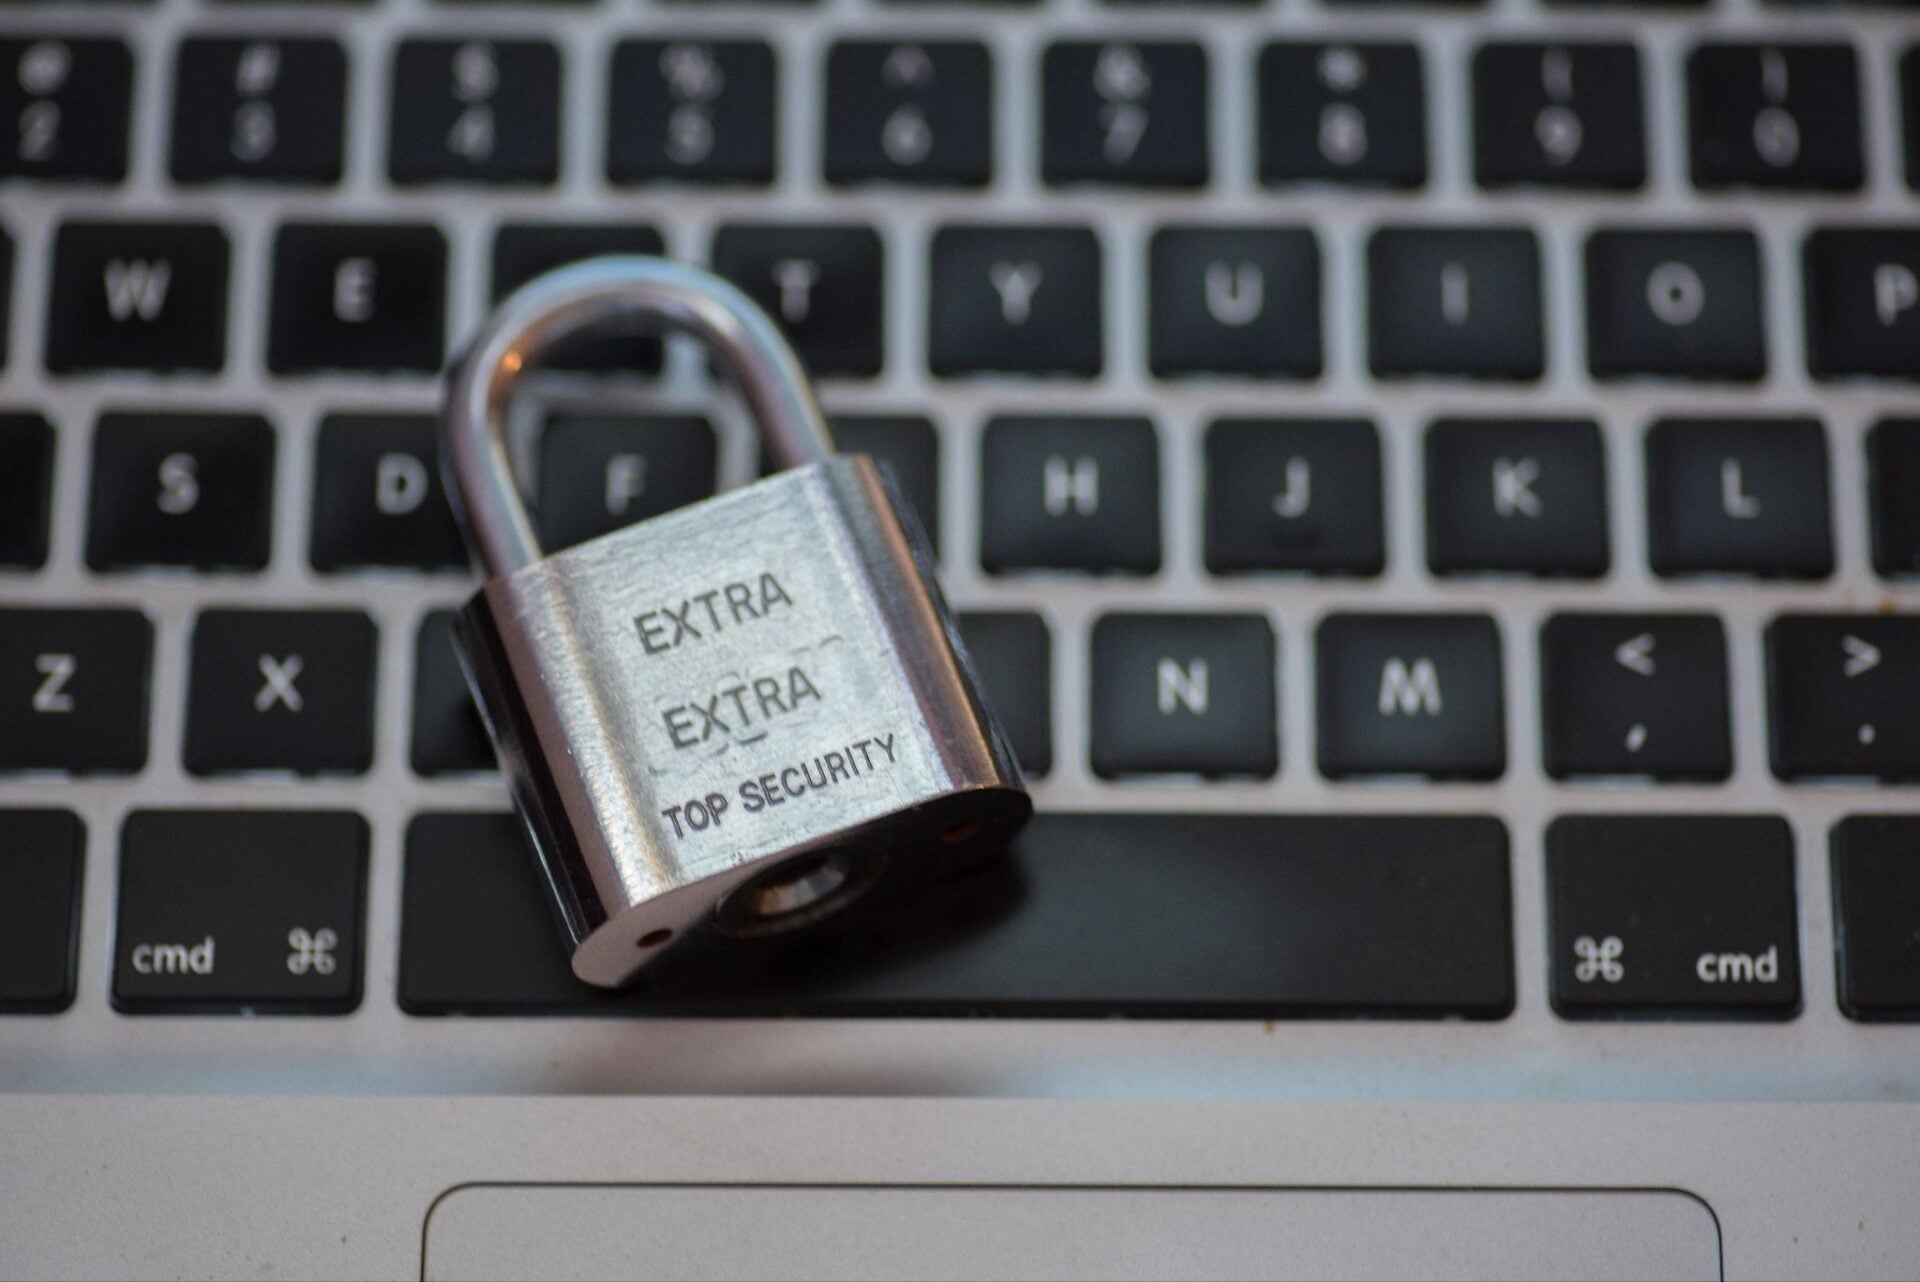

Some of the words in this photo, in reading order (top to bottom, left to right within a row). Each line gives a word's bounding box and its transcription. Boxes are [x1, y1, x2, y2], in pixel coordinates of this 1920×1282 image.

[105, 260, 170, 320] W
[335, 259, 377, 320] E
[773, 260, 818, 321] T
[991, 262, 1041, 323] Y
[1205, 264, 1263, 324] U
[1648, 263, 1704, 324] O
[1875, 266, 1917, 321] P
[158, 452, 199, 515] S
[377, 454, 427, 513] D
[607, 455, 645, 513] F
[1042, 457, 1100, 514] H
[1274, 457, 1311, 518] J
[1491, 459, 1540, 516] K
[1720, 459, 1759, 519] L
[633, 572, 793, 655] EXTRA
[32, 653, 76, 713] Z
[254, 654, 303, 712] X
[661, 666, 822, 749] EXTRA
[1156, 657, 1210, 715] N
[1377, 658, 1443, 716] M
[661, 793, 728, 839] TOP
[739, 733, 898, 814] SECURITY
[133, 938, 214, 973] cmd
[1697, 947, 1777, 981] cmd
